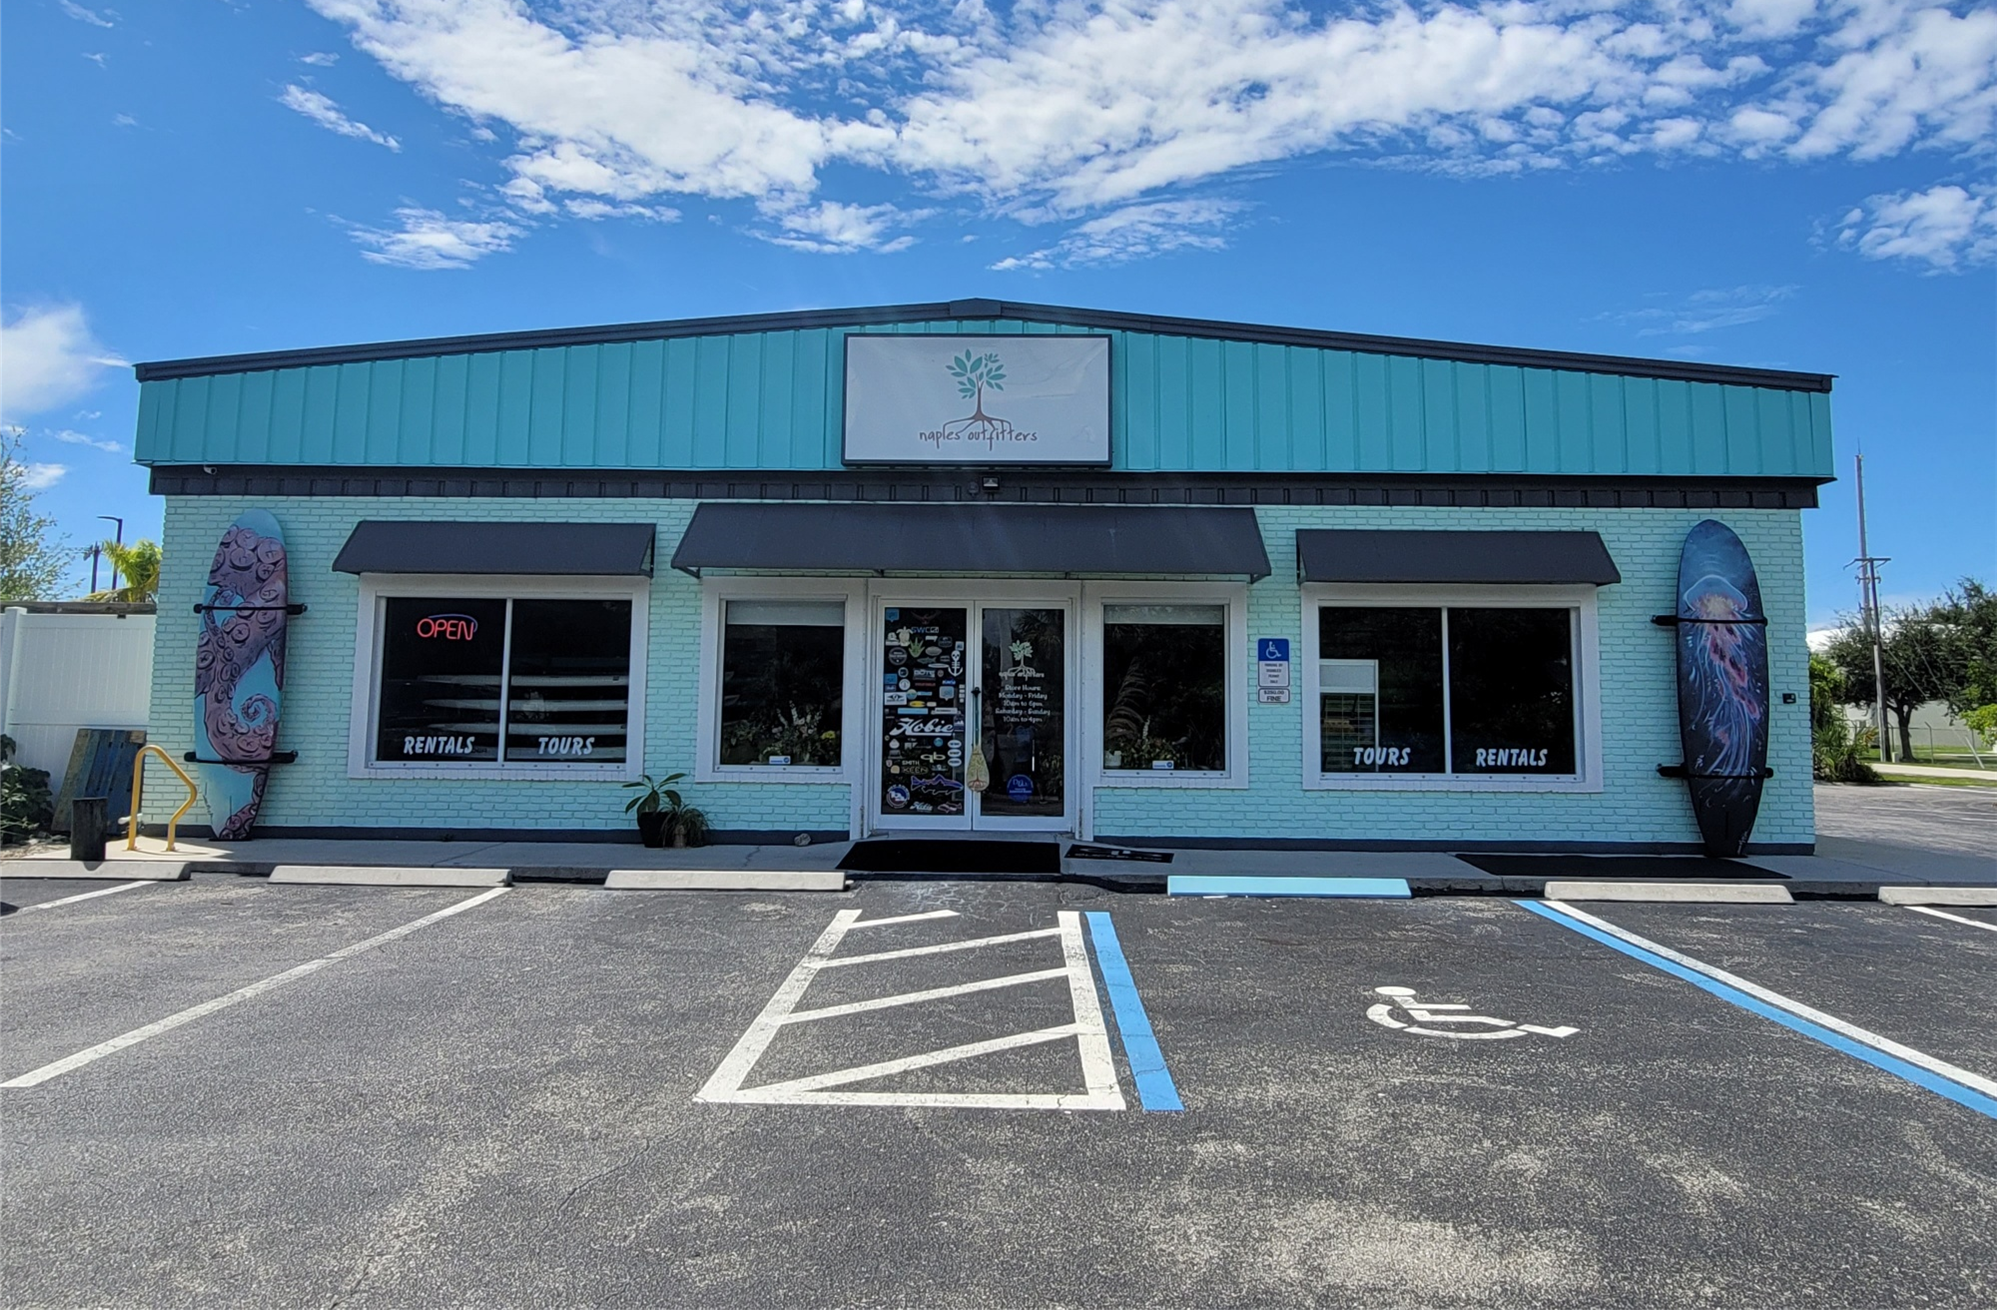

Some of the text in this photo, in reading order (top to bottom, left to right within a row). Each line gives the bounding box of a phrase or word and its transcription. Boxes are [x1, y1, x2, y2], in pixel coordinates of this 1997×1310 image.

[919, 424, 1038, 451] naples outfitters
[416, 617, 475, 641] OPEN
[889, 717, 953, 737] Hobie
[403, 736, 475, 755] RENTALS
[538, 737, 595, 755] TOURS
[1353, 747, 1411, 766] TOURS
[1475, 748, 1549, 767] RENTALS
